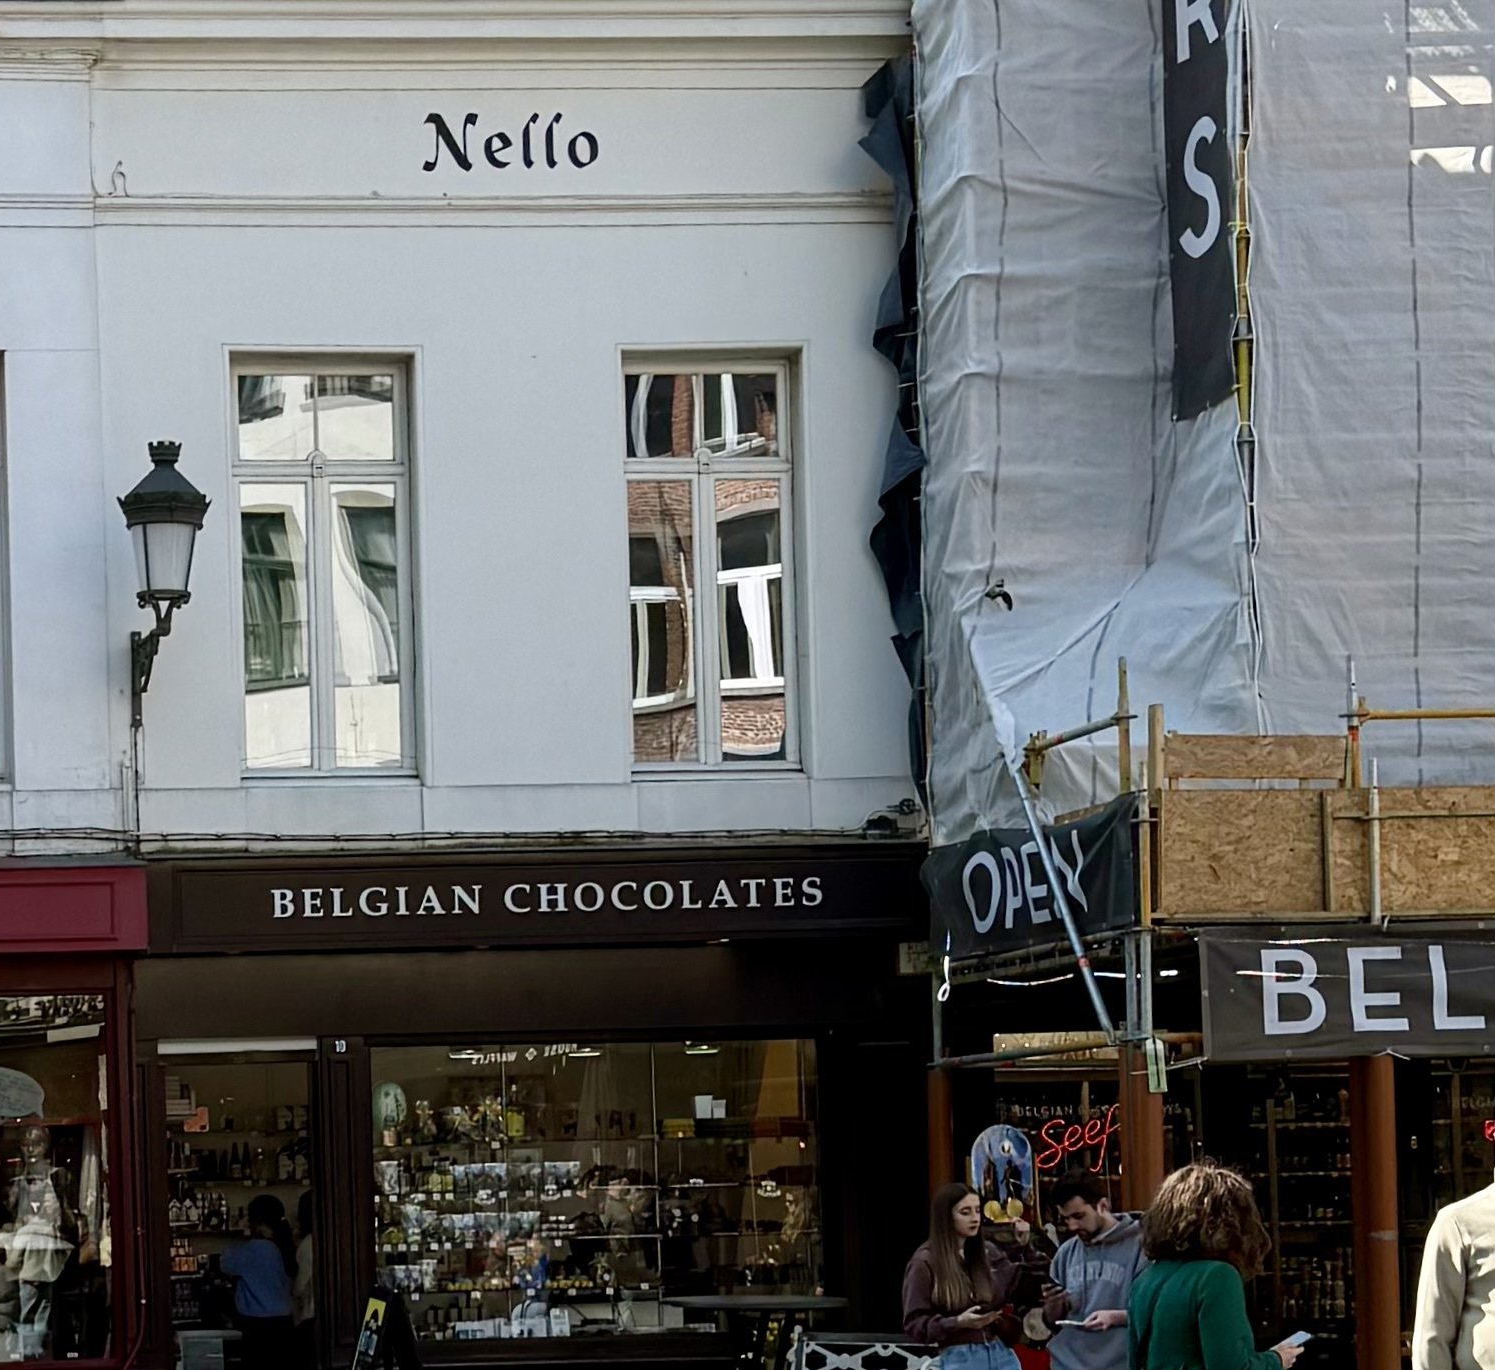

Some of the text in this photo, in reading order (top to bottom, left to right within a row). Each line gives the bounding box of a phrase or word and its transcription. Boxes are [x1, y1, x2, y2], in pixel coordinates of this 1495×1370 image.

[422, 112, 599, 172] Nello
[271, 876, 825, 918] BELGIAN CHOCOLATES
[962, 829, 1088, 934] OPEN
[1260, 944, 1486, 1035] BEL
[1036, 1103, 1120, 1173] Seef
